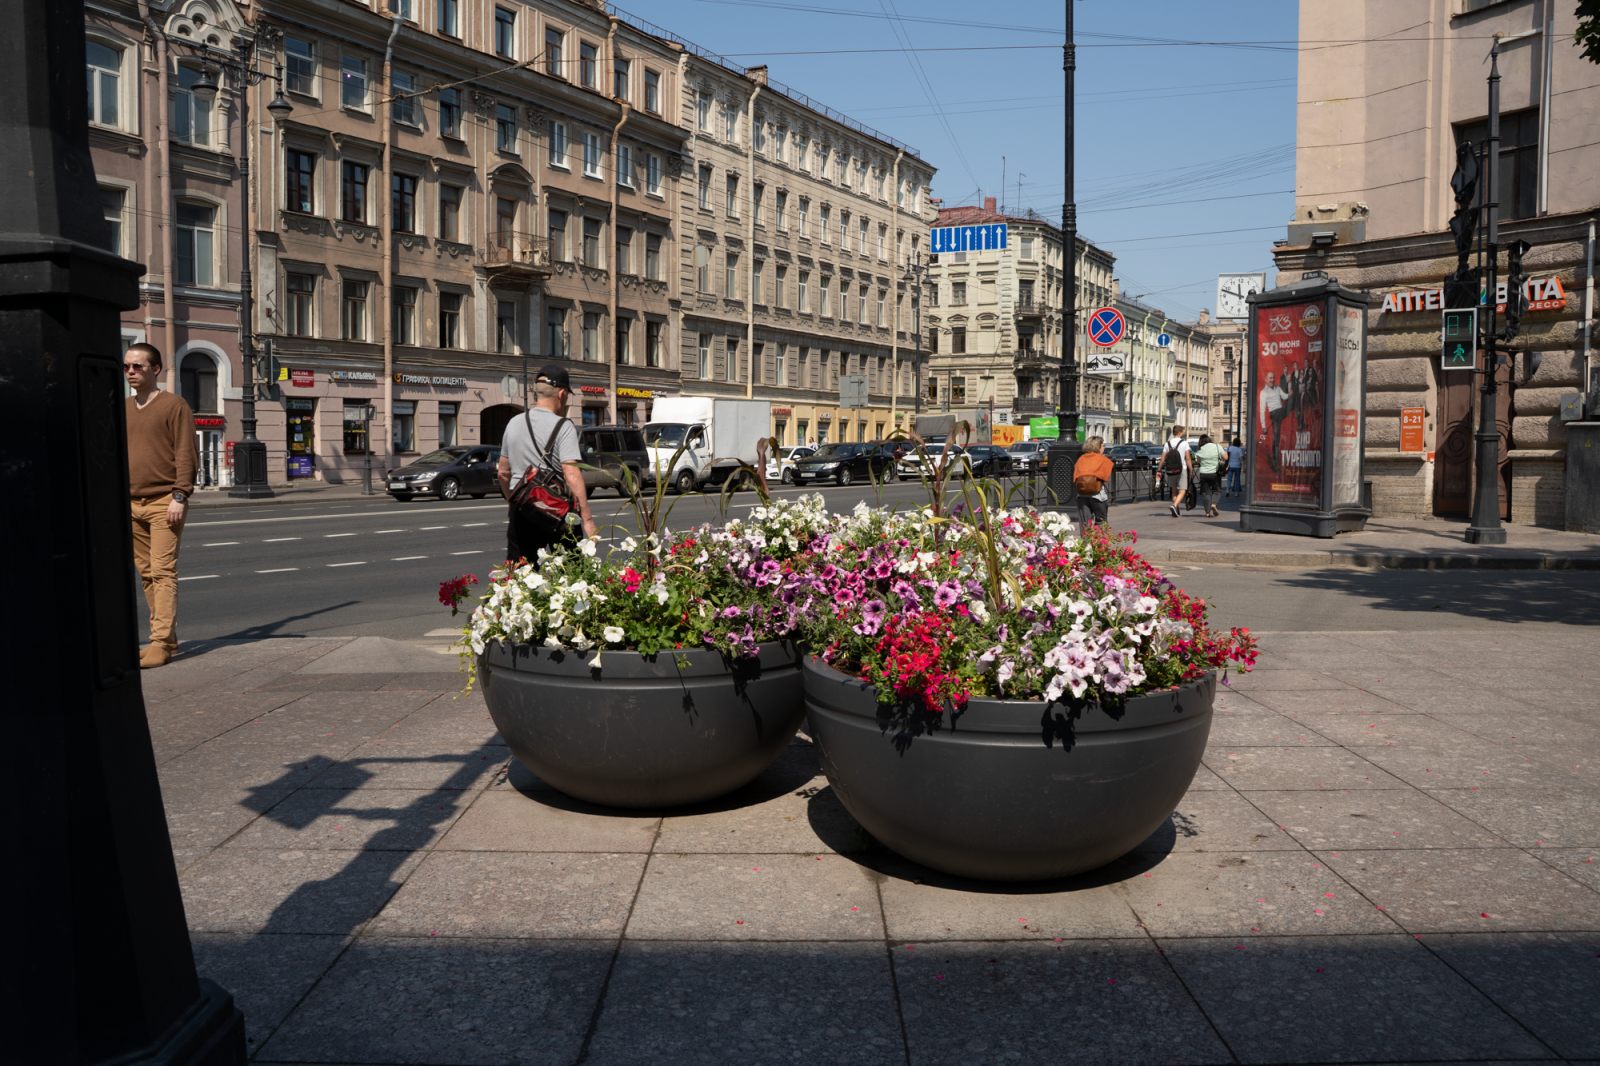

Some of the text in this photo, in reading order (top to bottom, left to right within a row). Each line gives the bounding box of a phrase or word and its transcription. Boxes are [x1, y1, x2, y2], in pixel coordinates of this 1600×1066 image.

[1381, 290, 1445, 313] АПТЕ
[1496, 300, 1560, 312] ЭРЕСС
[1262, 341, 1278, 356] 30
[1279, 340, 1300, 348] ИЮНЯ
[348, 371, 376, 380] КАЛЬЯНЫ
[402, 374, 467, 386] ГРАФИКА КОПИЦЕНТР
[1403, 415, 1421, 423] 8-21
[1295, 431, 1311, 449] ХОР
[1281, 450, 1321, 467] ТУРЕЦКОГО
